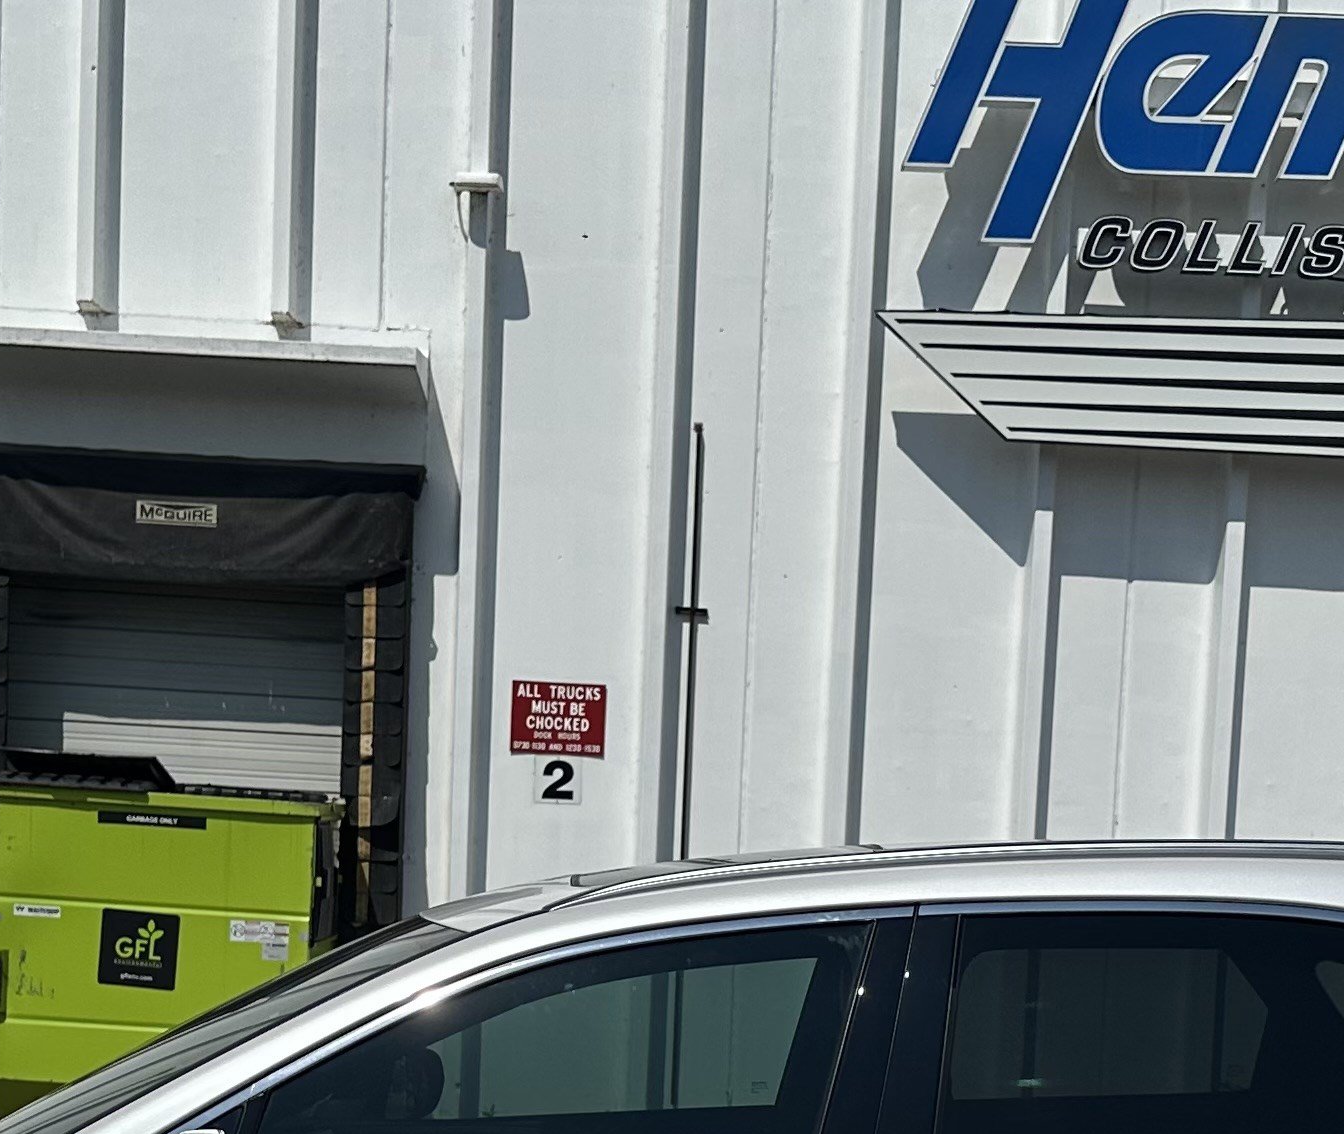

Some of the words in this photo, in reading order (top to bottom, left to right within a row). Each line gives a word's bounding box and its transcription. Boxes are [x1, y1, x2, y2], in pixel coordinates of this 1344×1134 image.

[517, 683, 541, 698] ALL
[549, 685, 601, 701] TRUCKS
[531, 700, 566, 715] MUST
[570, 702, 586, 716] BE
[526, 715, 590, 732] CHOCKED
[542, 760, 574, 800] 2
[115, 930, 163, 960] GFL
